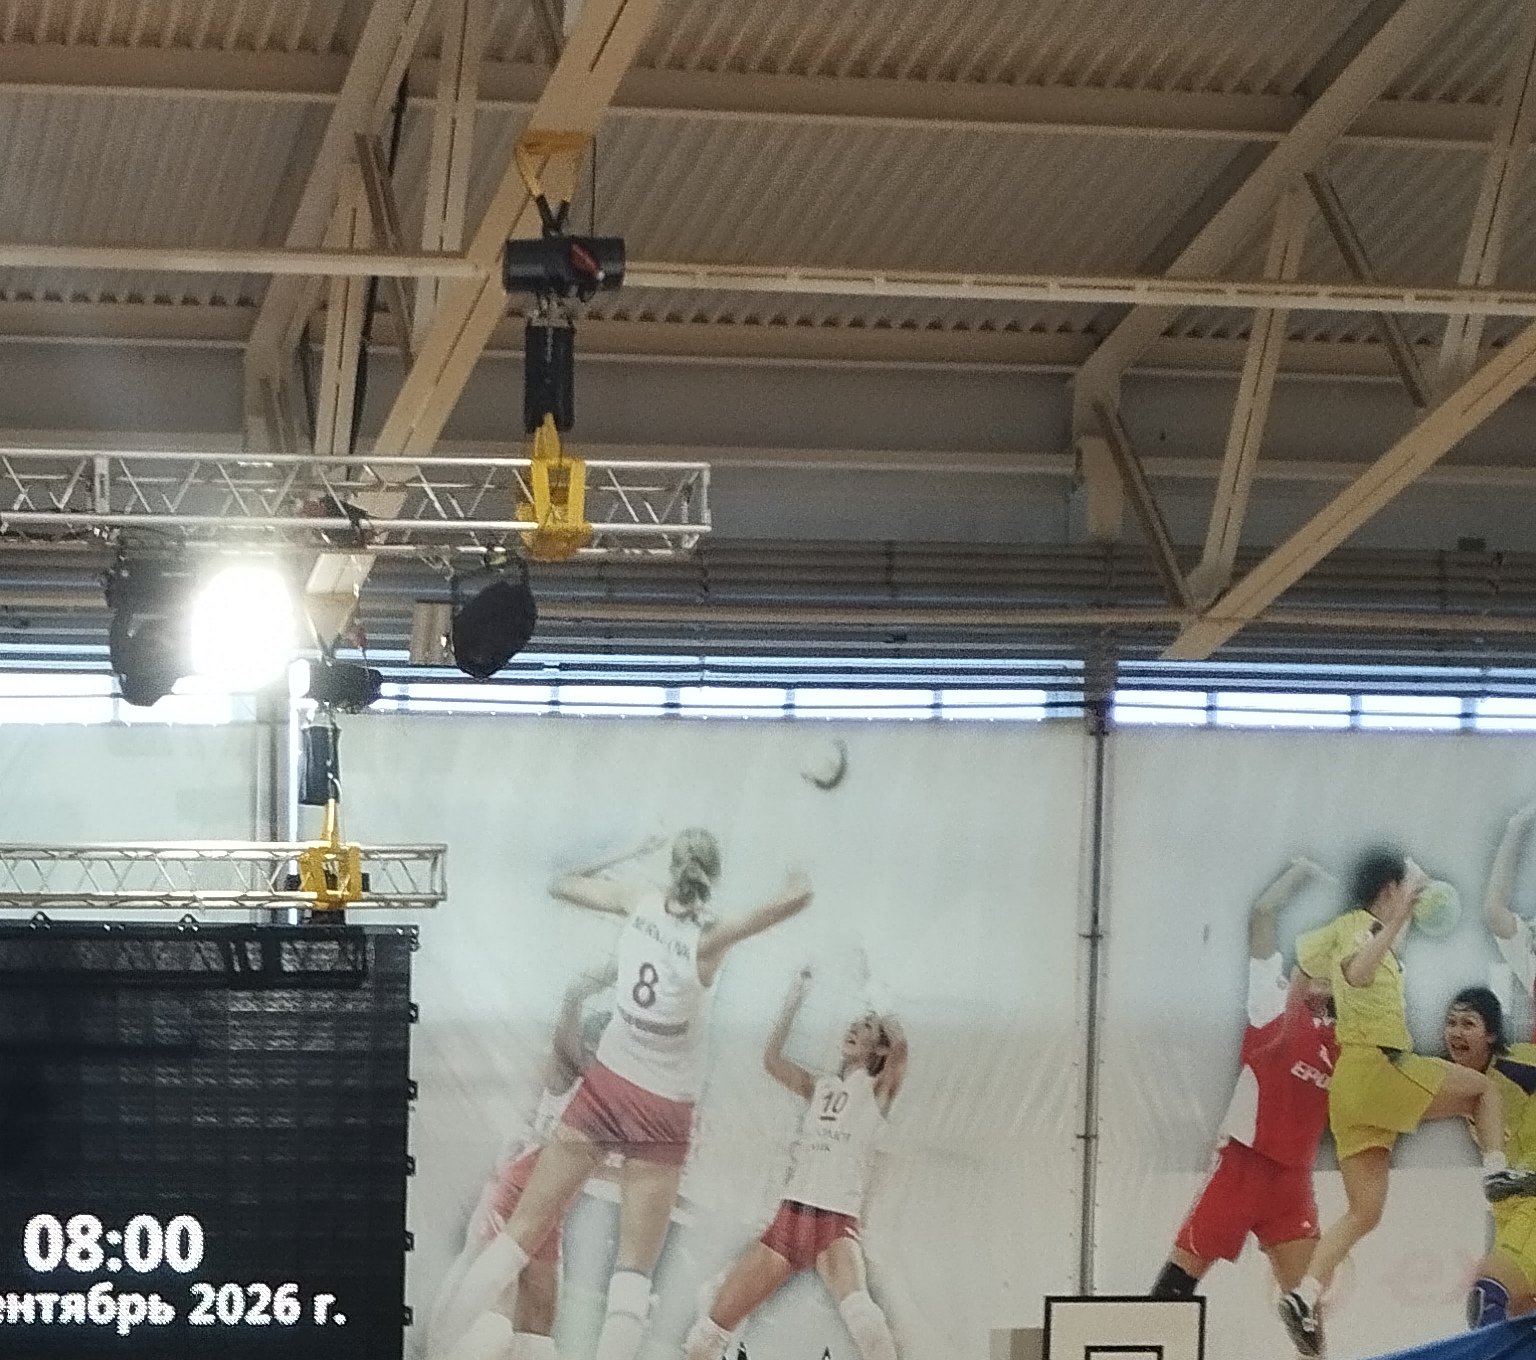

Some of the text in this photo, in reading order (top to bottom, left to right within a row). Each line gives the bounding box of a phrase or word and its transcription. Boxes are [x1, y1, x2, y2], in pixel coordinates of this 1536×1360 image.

[632, 961, 659, 1009] 8
[823, 1090, 849, 1113] 10
[22, 1213, 205, 1274] 08:00
[187, 1282, 302, 1326] 2026
[313, 1293, 348, 1326] г.
